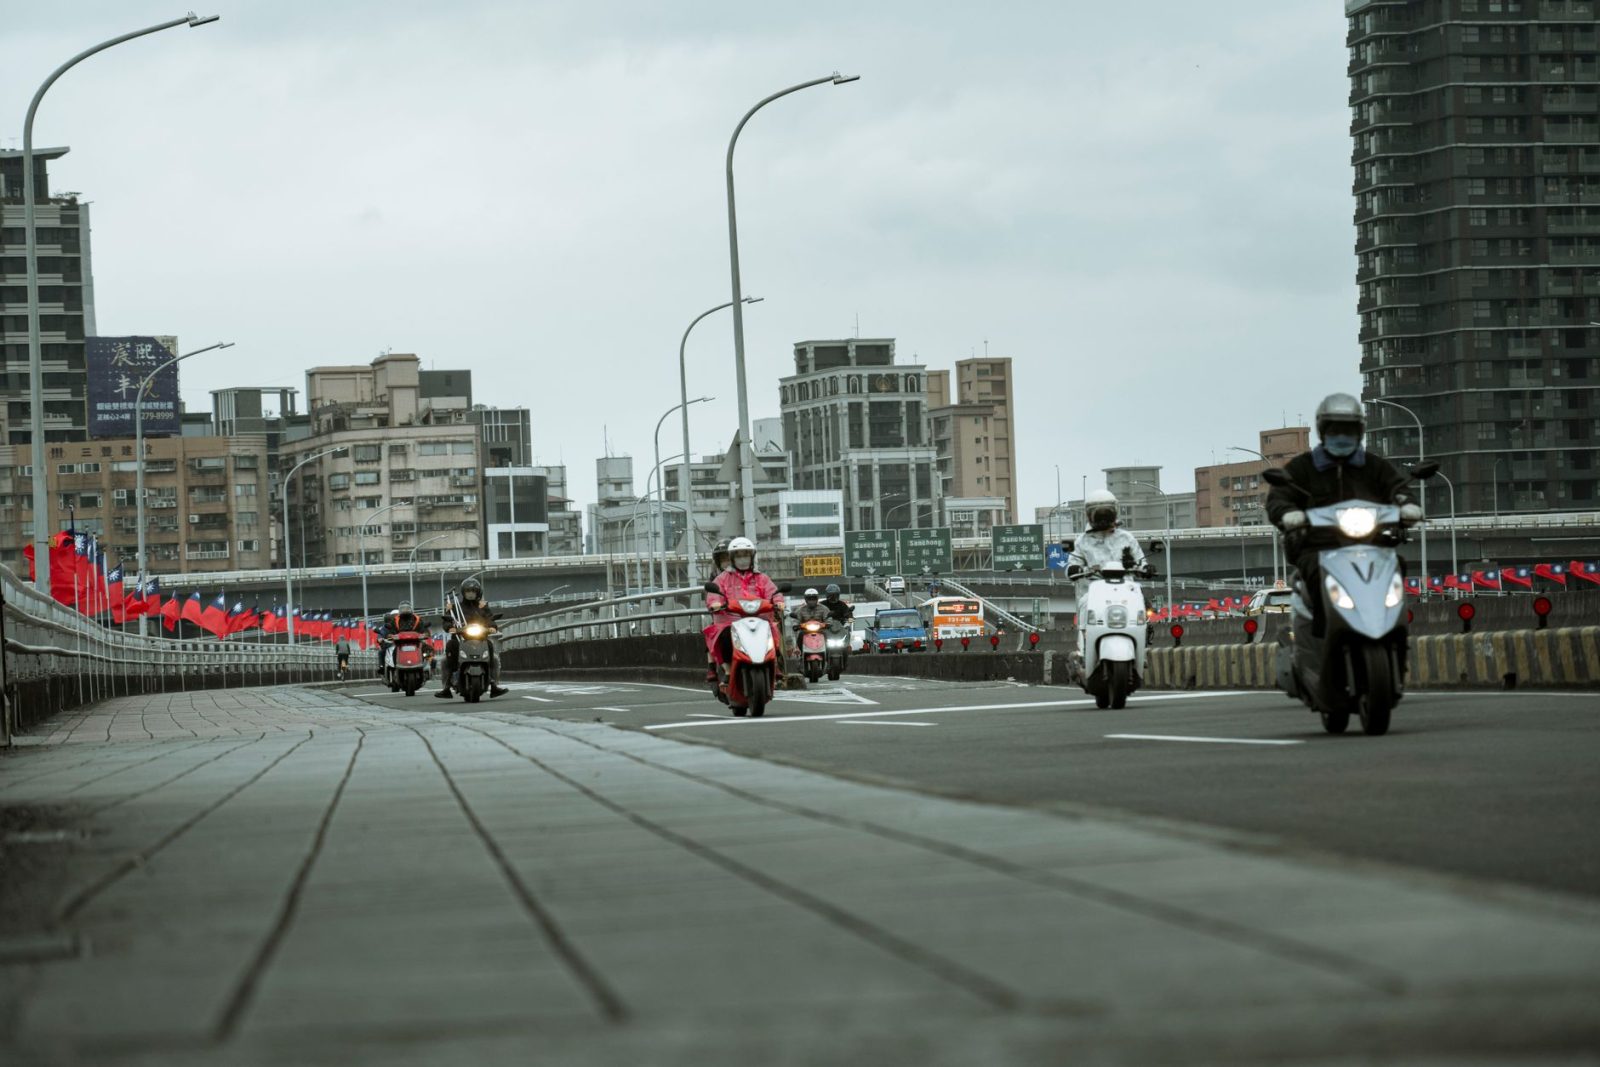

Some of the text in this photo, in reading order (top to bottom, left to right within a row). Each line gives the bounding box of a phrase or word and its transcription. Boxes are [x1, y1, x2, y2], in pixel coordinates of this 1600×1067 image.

[913, 530, 938, 538] 三重
[1005, 526, 1030, 534] 三重
[858, 532, 882, 540] 三重
